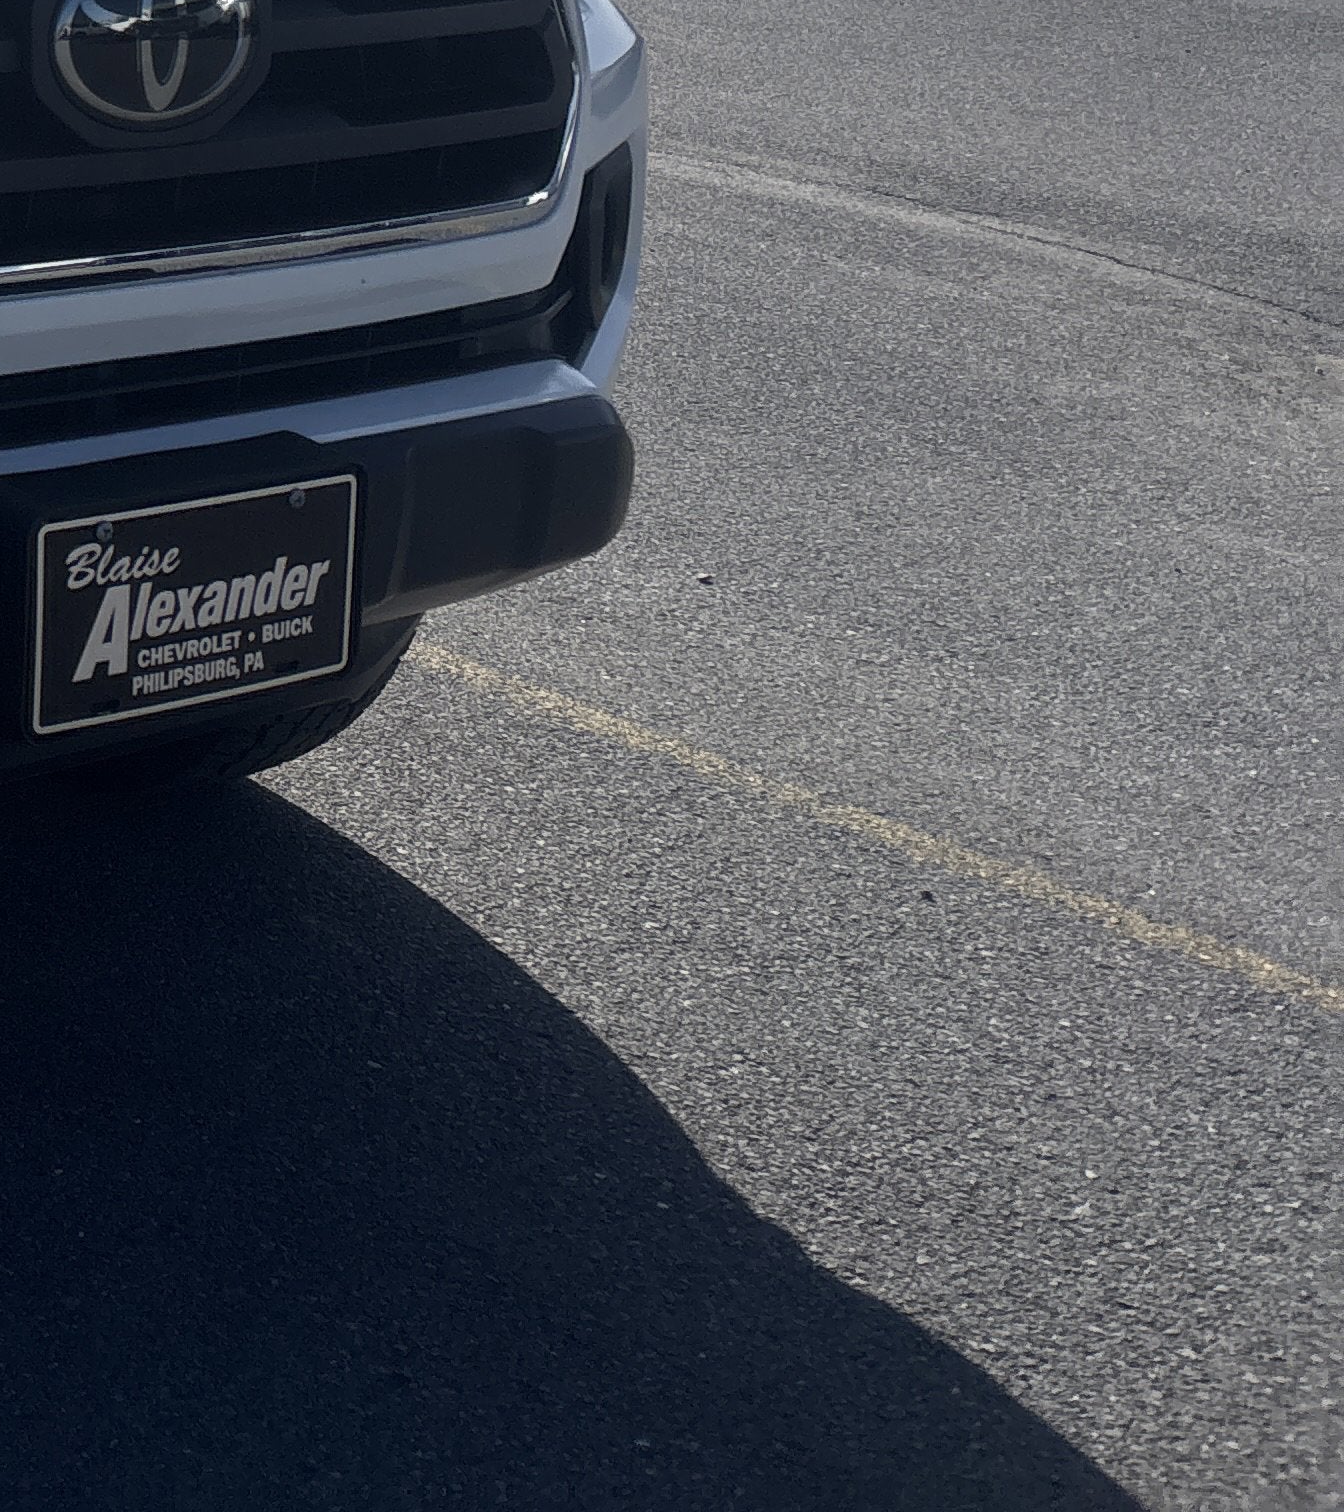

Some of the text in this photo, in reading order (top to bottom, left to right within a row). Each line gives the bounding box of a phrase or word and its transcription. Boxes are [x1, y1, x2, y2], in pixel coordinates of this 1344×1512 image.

[64, 542, 181, 591] Blaise
[71, 555, 332, 684] Alexander
[136, 614, 314, 670] CHEVROLET BUICK
[131, 650, 265, 697] PHILIPSBURG, PA
